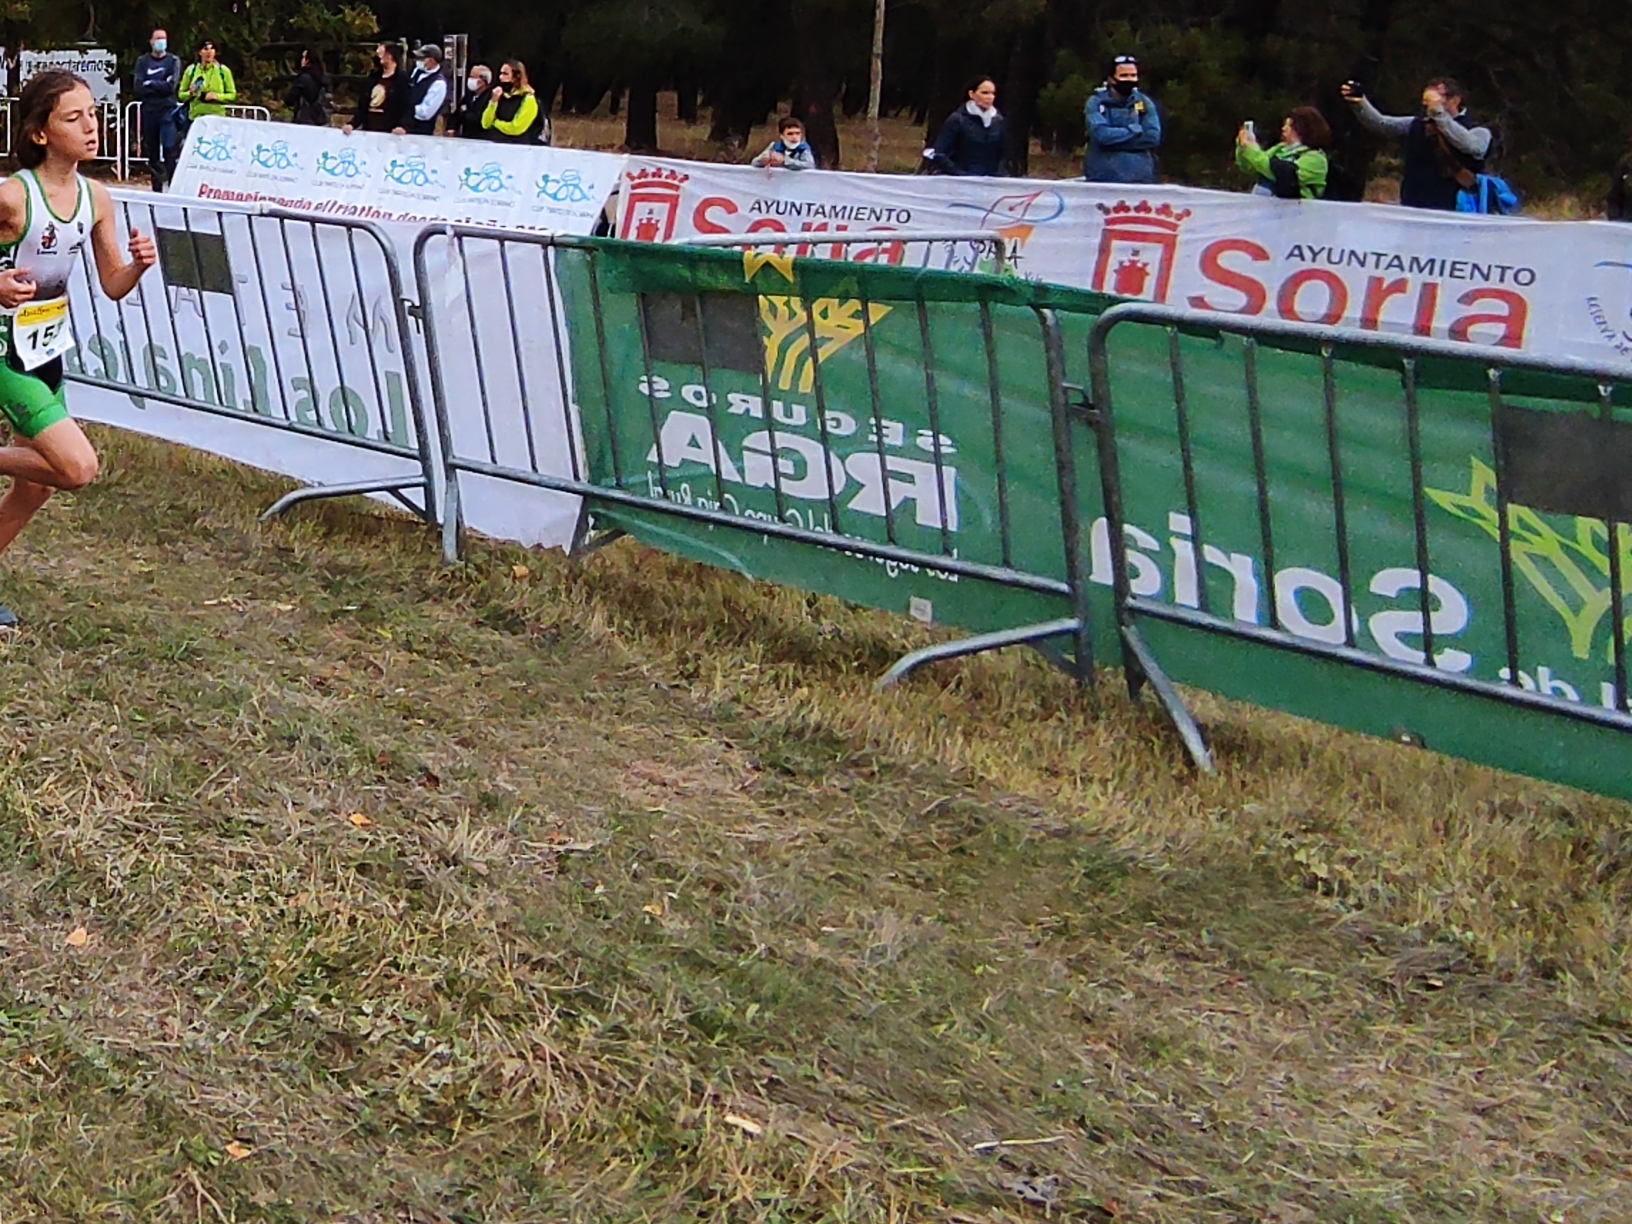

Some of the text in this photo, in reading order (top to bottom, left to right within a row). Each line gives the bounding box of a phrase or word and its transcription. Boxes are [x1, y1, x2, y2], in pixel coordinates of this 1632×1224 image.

[749, 198, 911, 224] AYUNTAMIENTO
[1285, 244, 1536, 287] AYUNTAMIENTO
[1187, 238, 1530, 350] Soria
